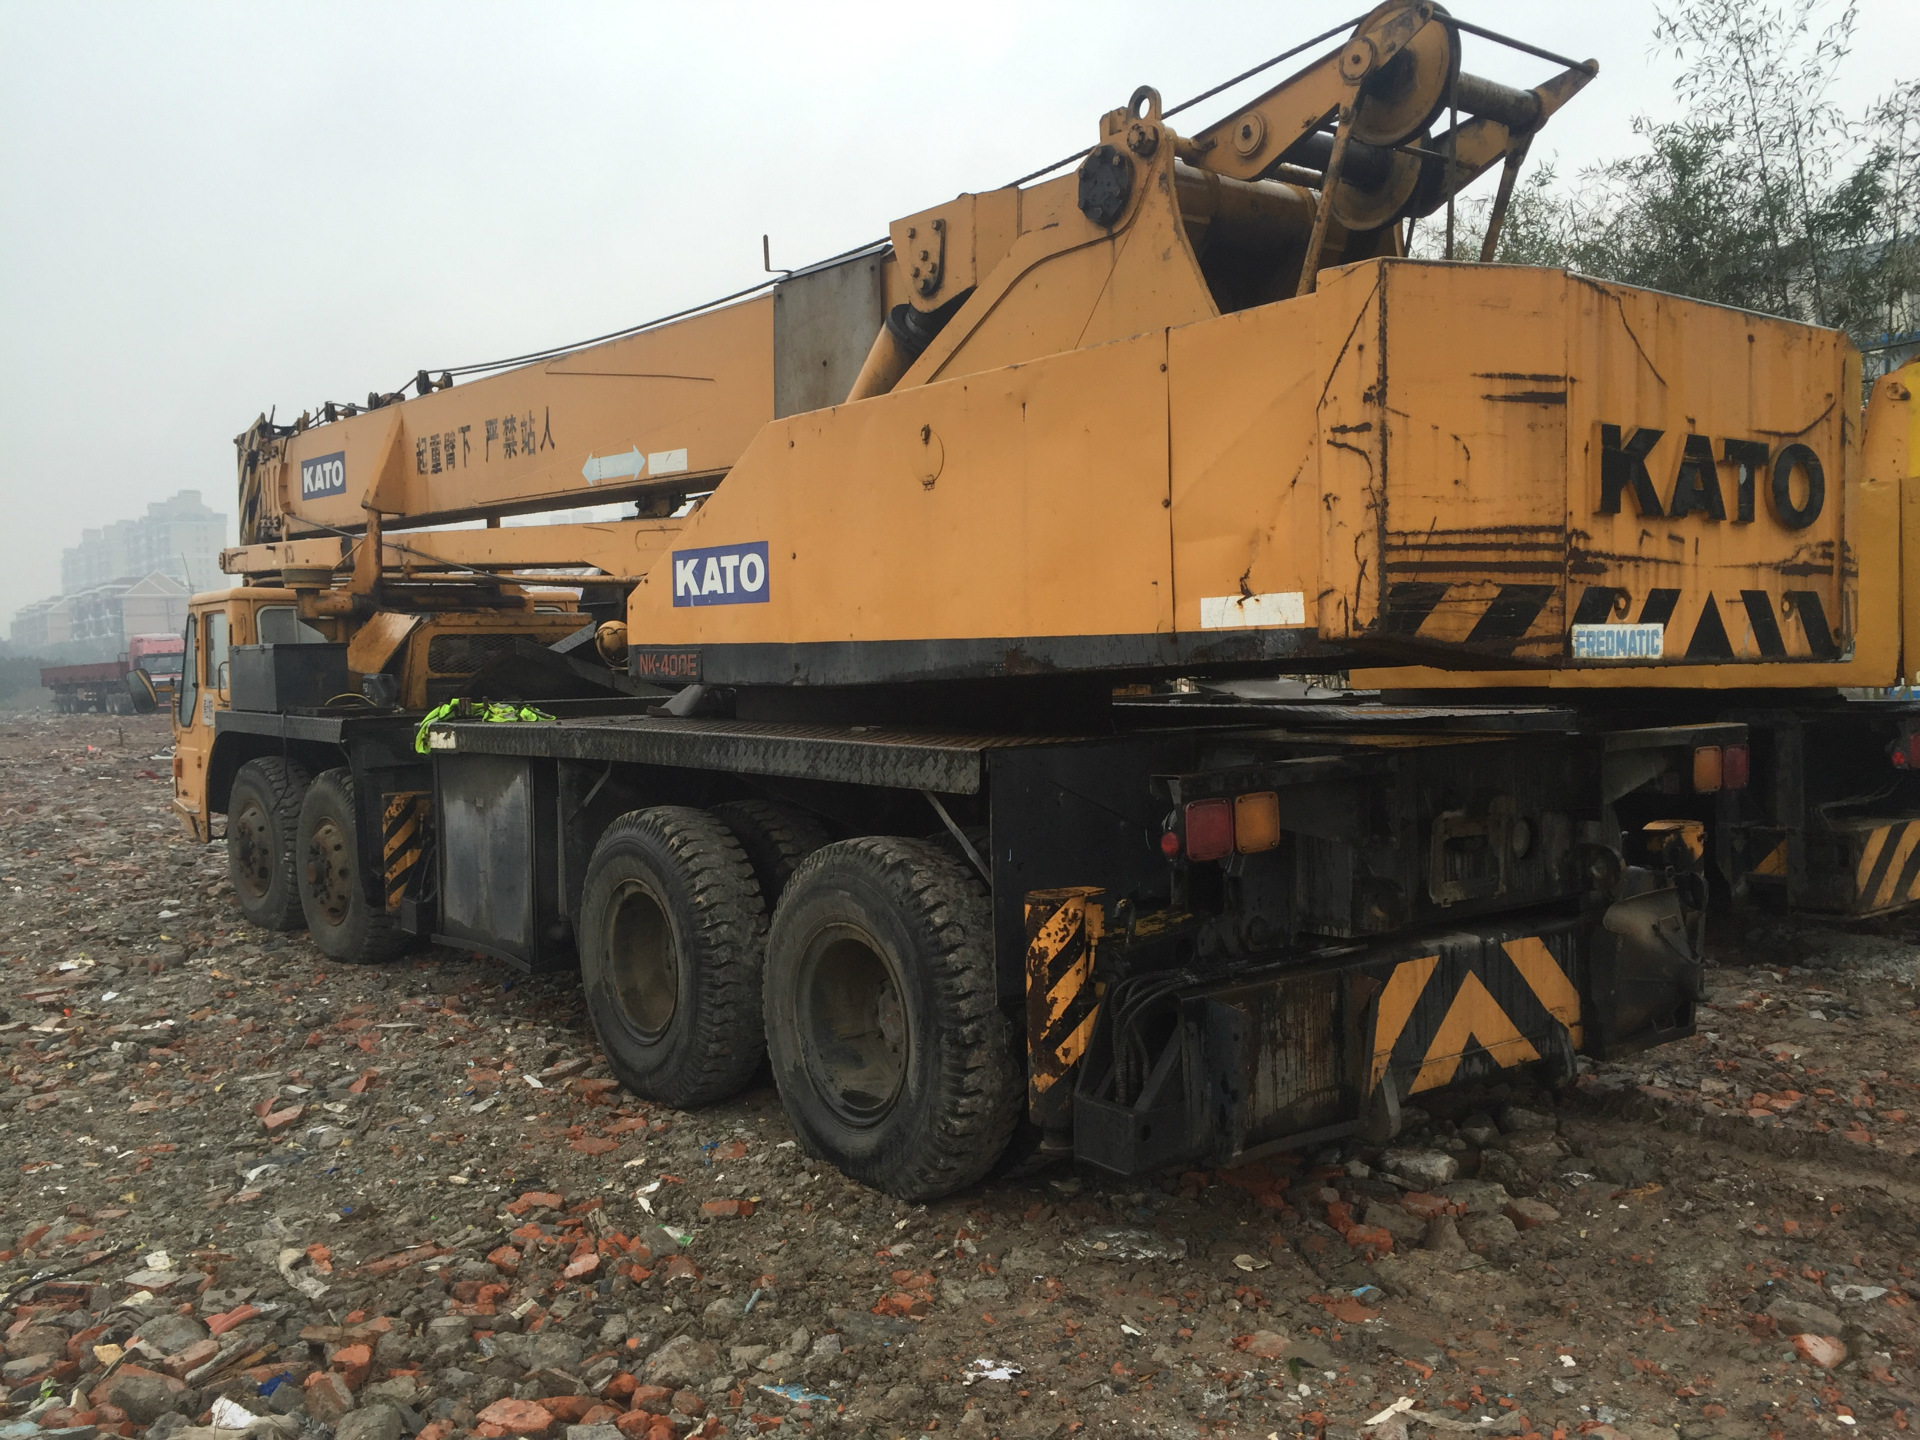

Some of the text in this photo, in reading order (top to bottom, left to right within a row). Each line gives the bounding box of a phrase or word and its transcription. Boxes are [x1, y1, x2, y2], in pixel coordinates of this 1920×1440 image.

[416, 405, 555, 476] 起重臂下 严禁站人
[303, 459, 344, 494] KATO
[1598, 422, 1826, 531] KATO
[675, 552, 765, 597] KATO
[639, 653, 697, 676] NK-400E
